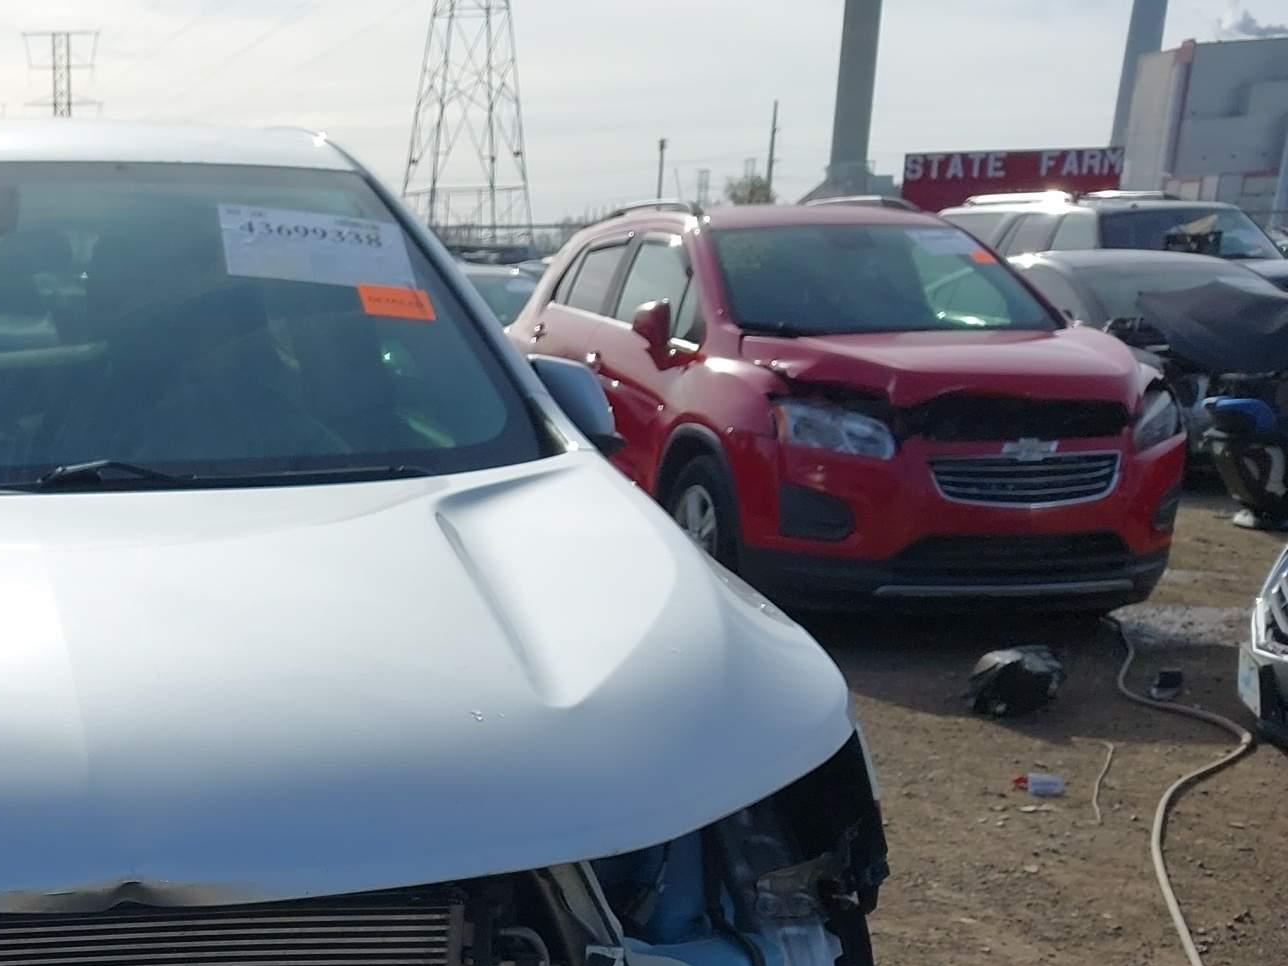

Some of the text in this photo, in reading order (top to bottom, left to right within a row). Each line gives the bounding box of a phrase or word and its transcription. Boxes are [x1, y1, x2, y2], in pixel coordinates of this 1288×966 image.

[905, 149, 1126, 180] STATE FARM
[240, 220, 383, 248] 43699338
